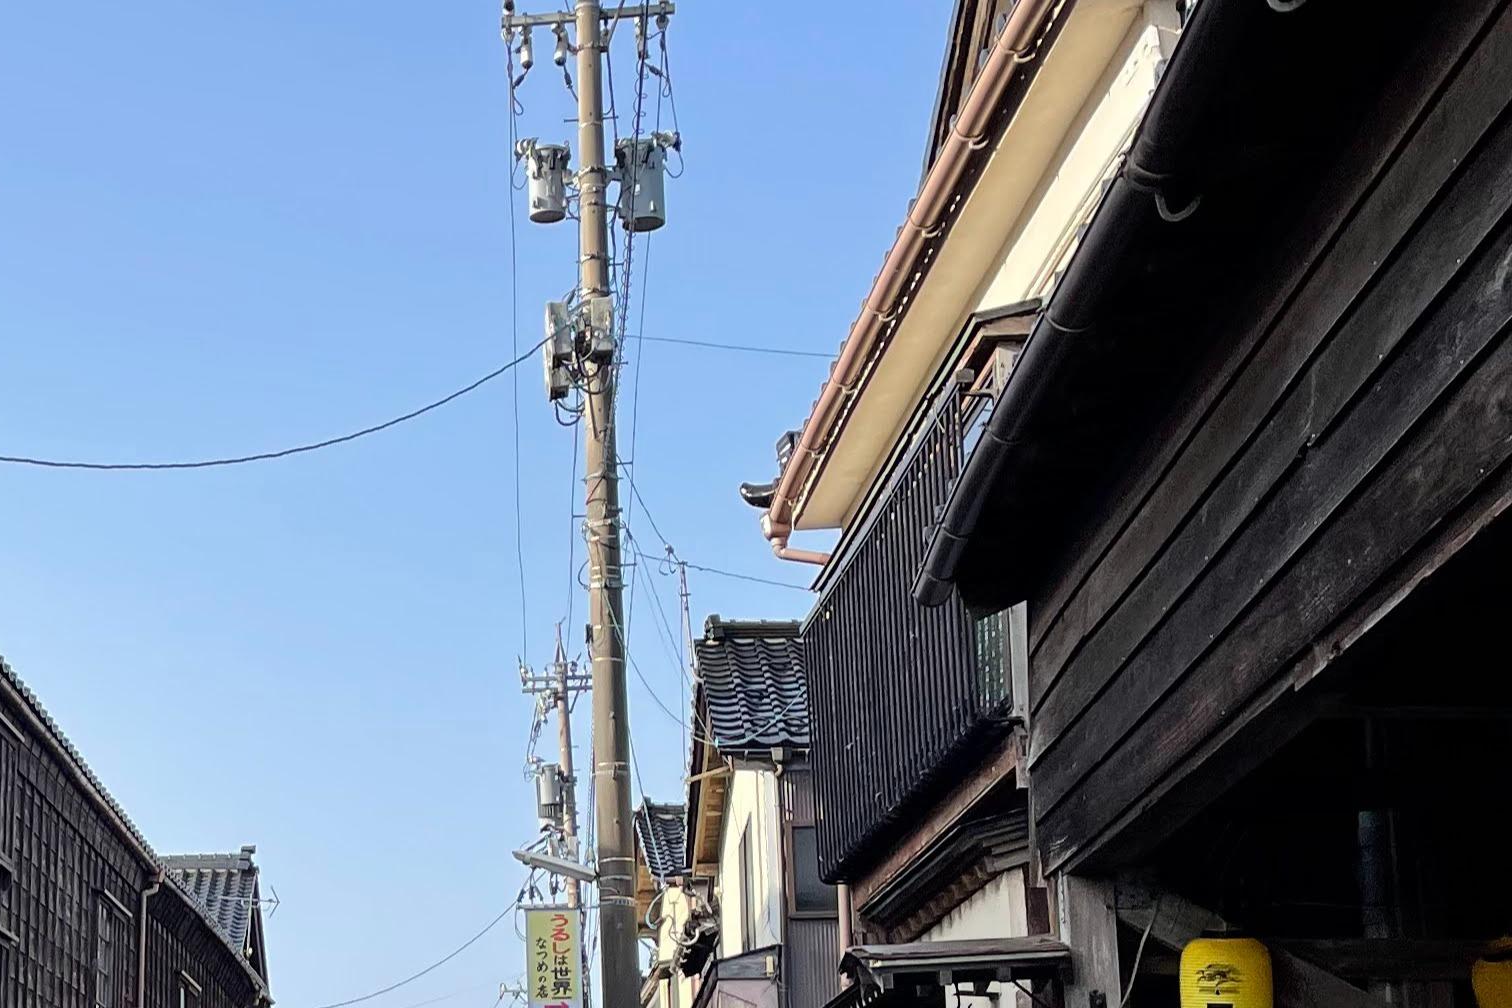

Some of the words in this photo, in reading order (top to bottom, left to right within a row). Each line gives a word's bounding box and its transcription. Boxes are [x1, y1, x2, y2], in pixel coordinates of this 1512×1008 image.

[536, 937, 548, 999] なつめの店
[551, 914, 572, 999] うるしは世界一
